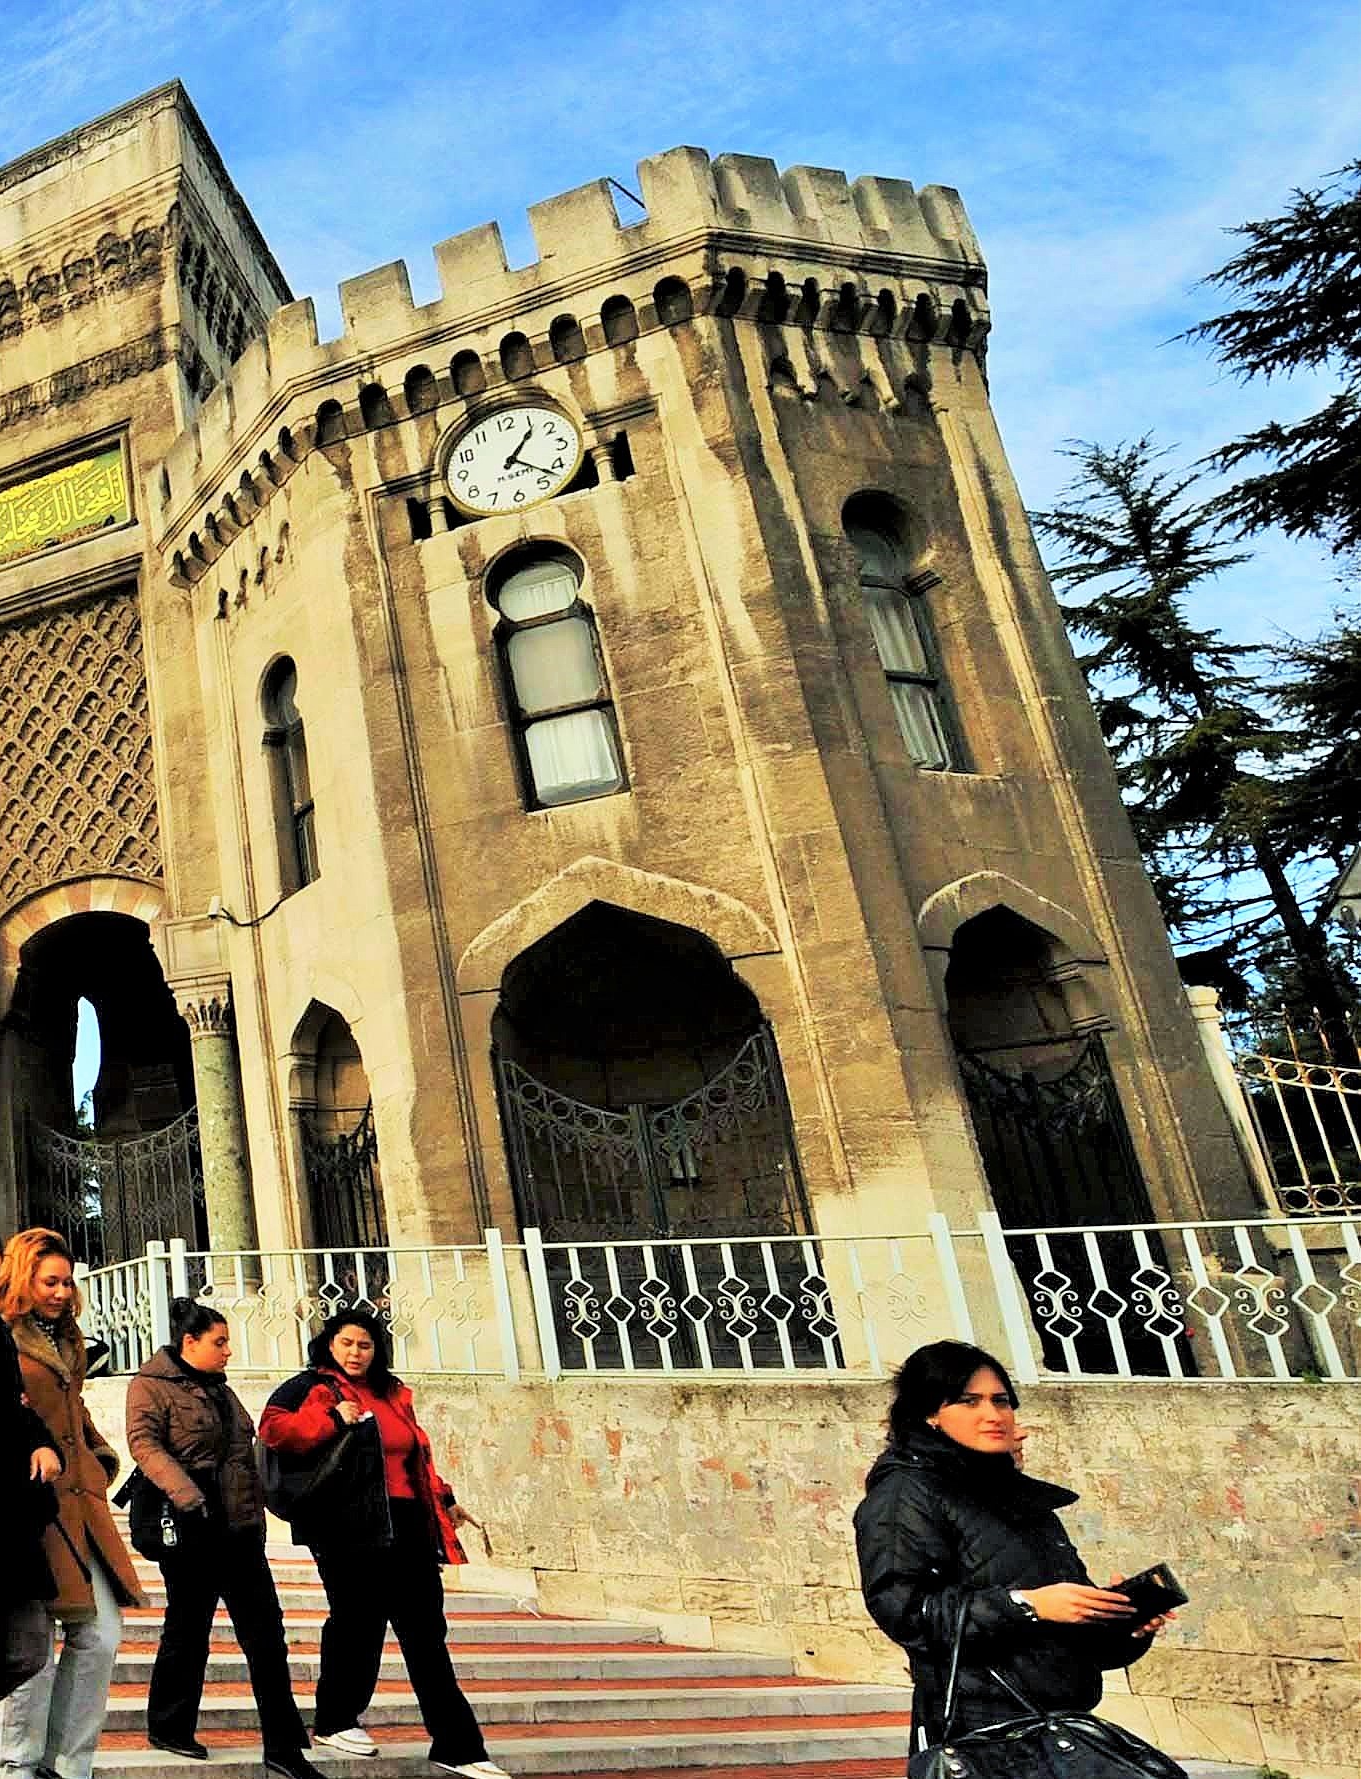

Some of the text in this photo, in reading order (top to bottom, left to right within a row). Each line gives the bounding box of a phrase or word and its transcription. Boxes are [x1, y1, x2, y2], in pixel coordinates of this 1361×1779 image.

[497, 416, 515, 432] 12
[543, 421, 557, 435] 2
[475, 431, 487, 445] 11
[555, 437, 568, 451] 3
[459, 449, 474, 463] 10
[551, 457, 565, 469] 4
[457, 470, 469, 482] 9
[536, 475, 550, 490] 5
[468, 485, 480, 498] 8
[486, 492, 498, 505] 7
[513, 489, 525, 502] 6
